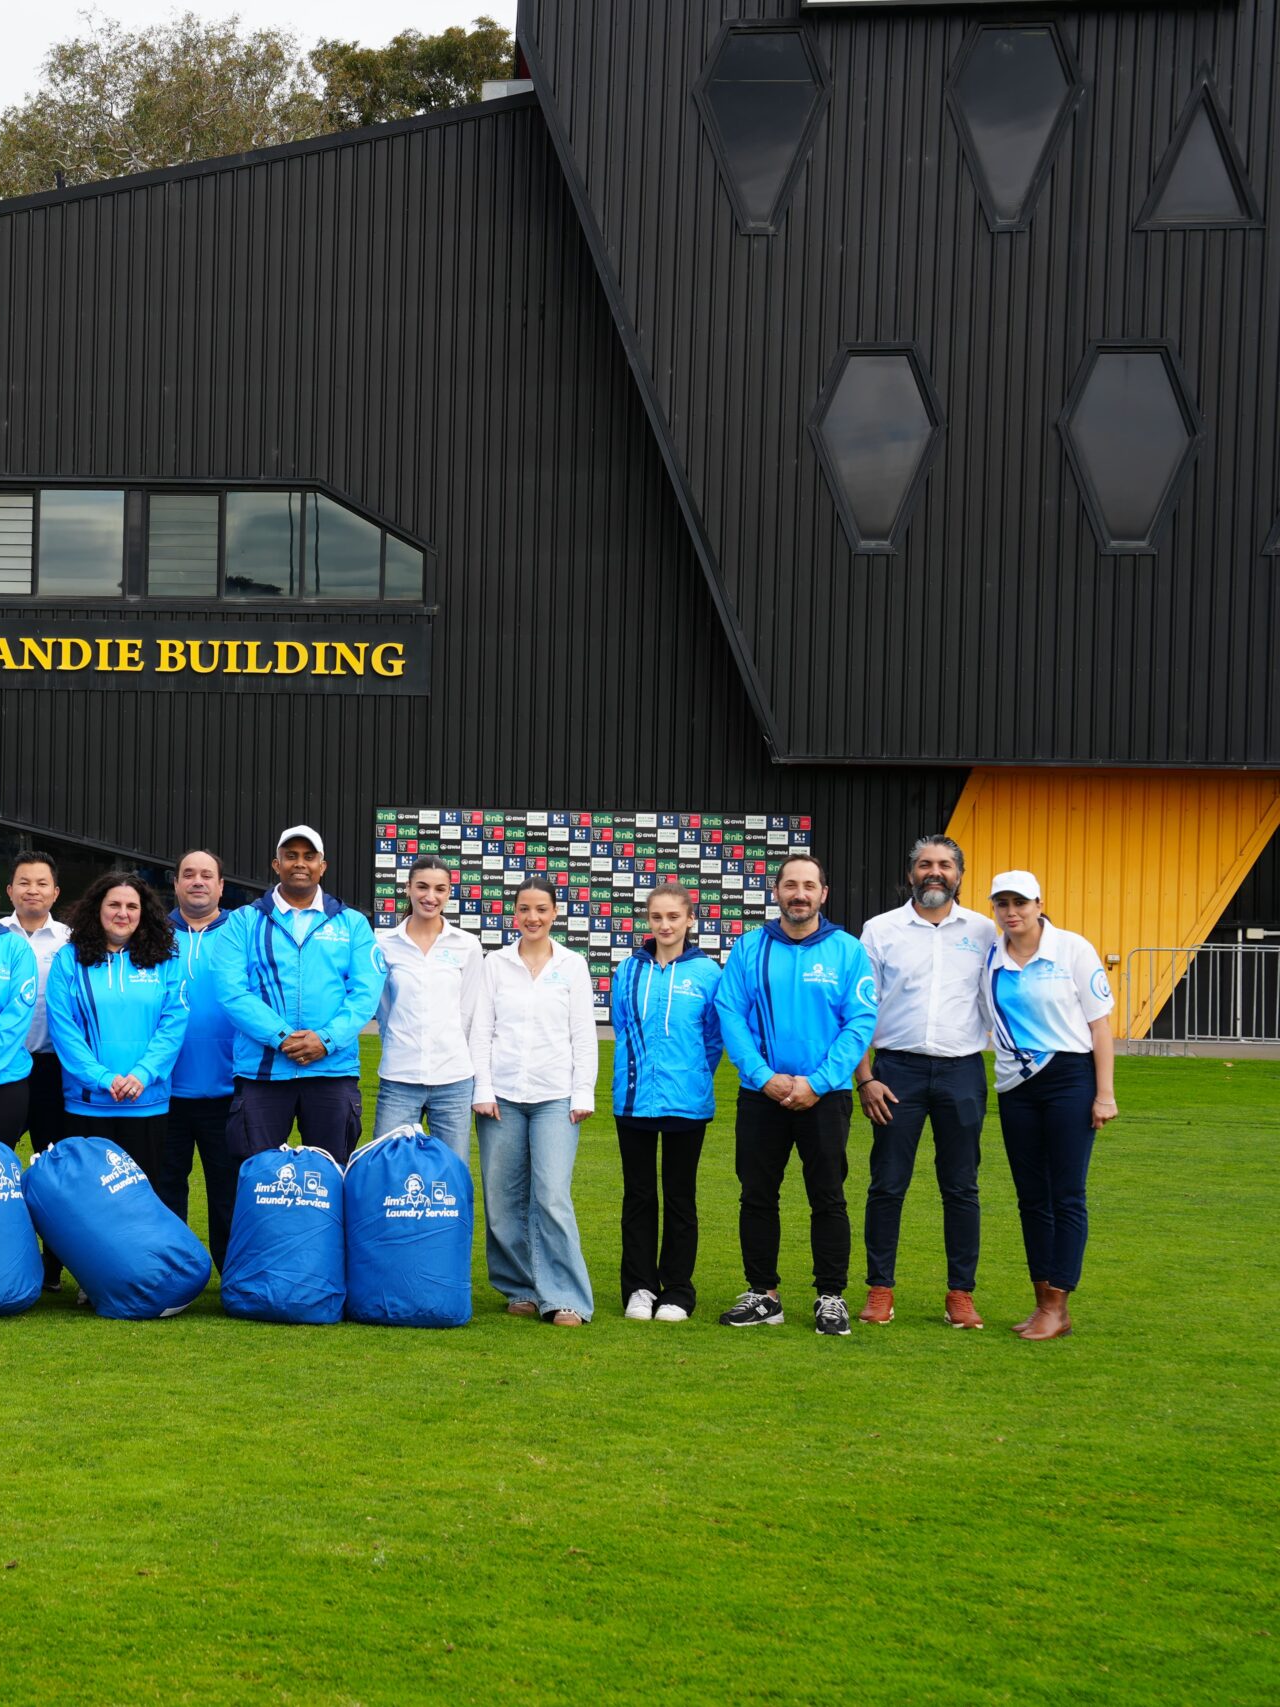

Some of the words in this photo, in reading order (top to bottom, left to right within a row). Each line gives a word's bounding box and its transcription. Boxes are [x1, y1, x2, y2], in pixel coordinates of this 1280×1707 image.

[155, 640, 406, 676] BUILDING
[384, 811, 396, 820] nib
[492, 813, 504, 822] nib
[600, 815, 612, 823] nib
[709, 816, 721, 825] nib
[405, 827, 417, 835] nib
[513, 828, 525, 837] nib
[621, 830, 633, 839] nib
[731, 832, 743, 840] nib
[426, 842, 438, 851] nib
[534, 844, 546, 852] nib
[643, 845, 655, 854] nib
[752, 847, 764, 856] nib
[447, 857, 459, 866] nib
[555, 859, 567, 868] nib
[664, 861, 676, 869] nib
[468, 873, 480, 881] nib
[577, 874, 589, 883] nib
[686, 876, 698, 885] nib
[382, 886, 394, 895] nib
[490, 888, 502, 896] nib
[598, 890, 610, 898] nib
[707, 891, 719, 900] nib
[620, 905, 632, 914] nib
[729, 907, 741, 915] nib
[597, 964, 609, 973] nib
[108, 1175, 138, 1194] Laundry
[254, 1182, 276, 1192] Jim's
[256, 1195, 293, 1207] Laundry
[295, 1197, 330, 1209] Services
[383, 1196, 405, 1206] Jim's
[386, 1208, 424, 1220] Laundry
[425, 1208, 458, 1217] Services
